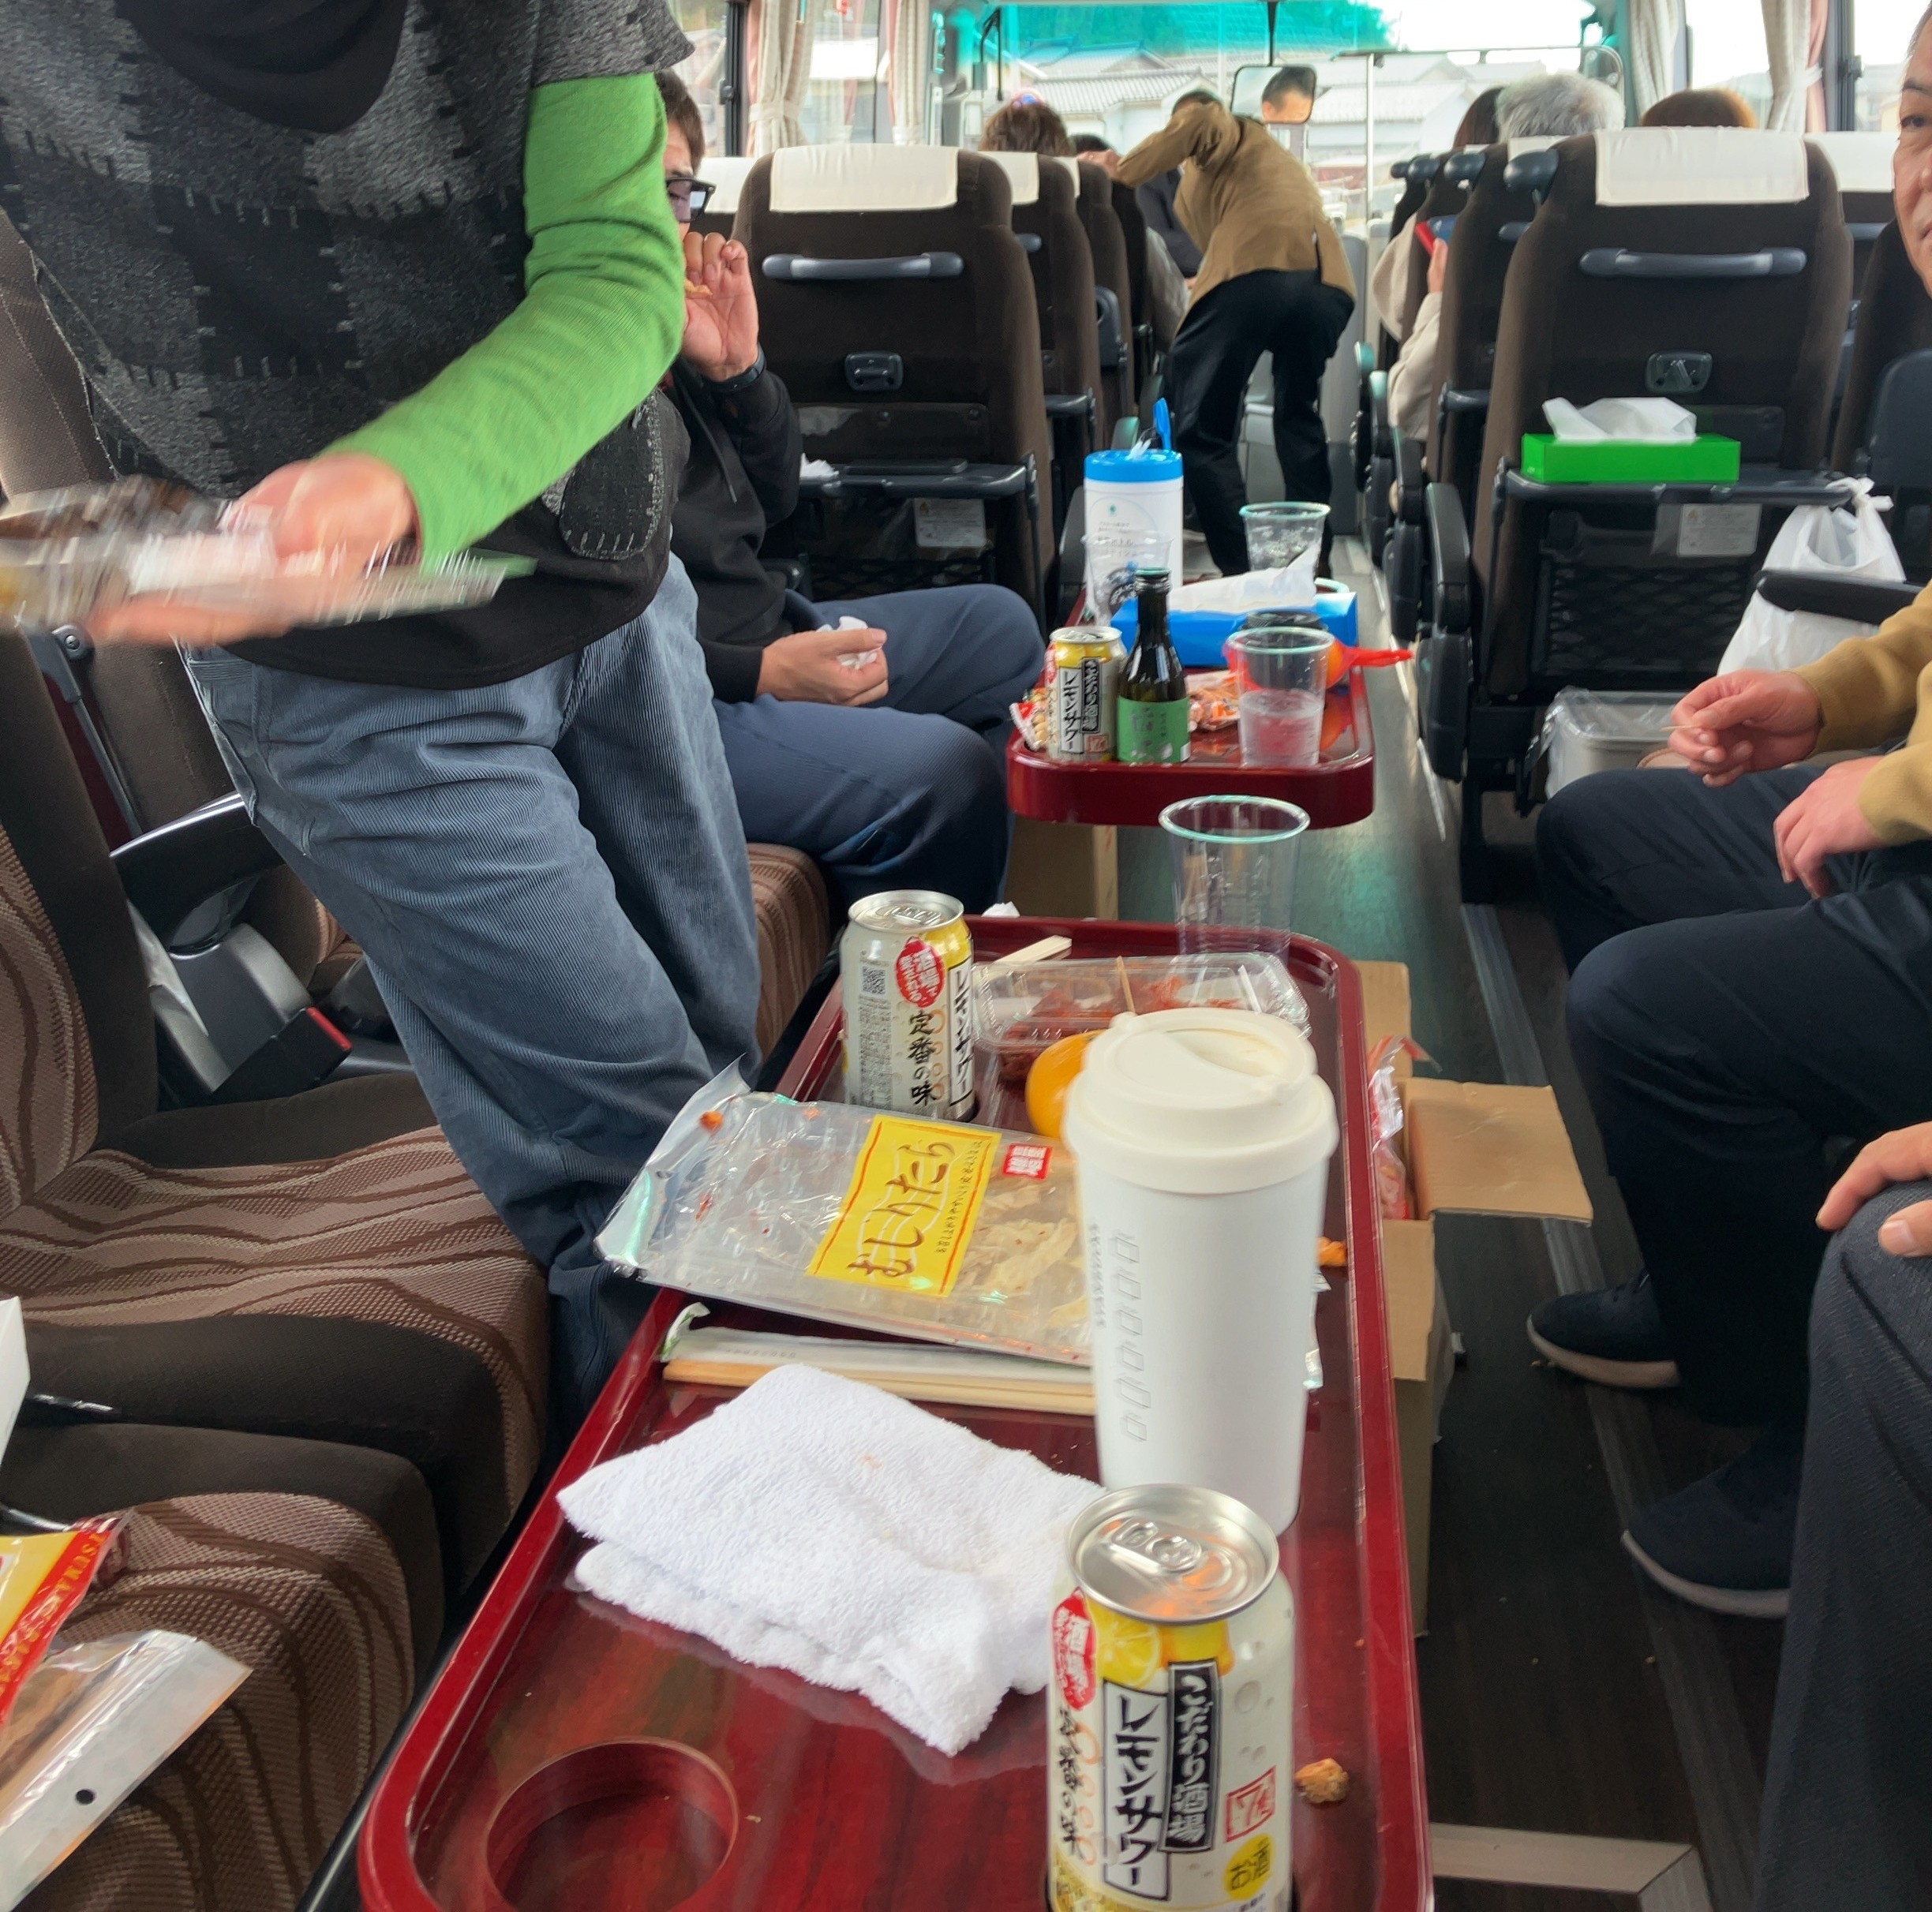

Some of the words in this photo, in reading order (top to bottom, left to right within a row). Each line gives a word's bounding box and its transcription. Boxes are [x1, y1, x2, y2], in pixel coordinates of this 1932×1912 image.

[1063, 671, 1081, 750] レモンサワー
[908, 1010, 938, 1106] 定番の味
[953, 970, 974, 1094] レモンサワー
[846, 1141, 956, 1278] むしりたら
[1115, 1694, 1163, 1886] レモンサワー
[1169, 1674, 1215, 1843] こだわり酒場
[1231, 1837, 1271, 1891] お酒
